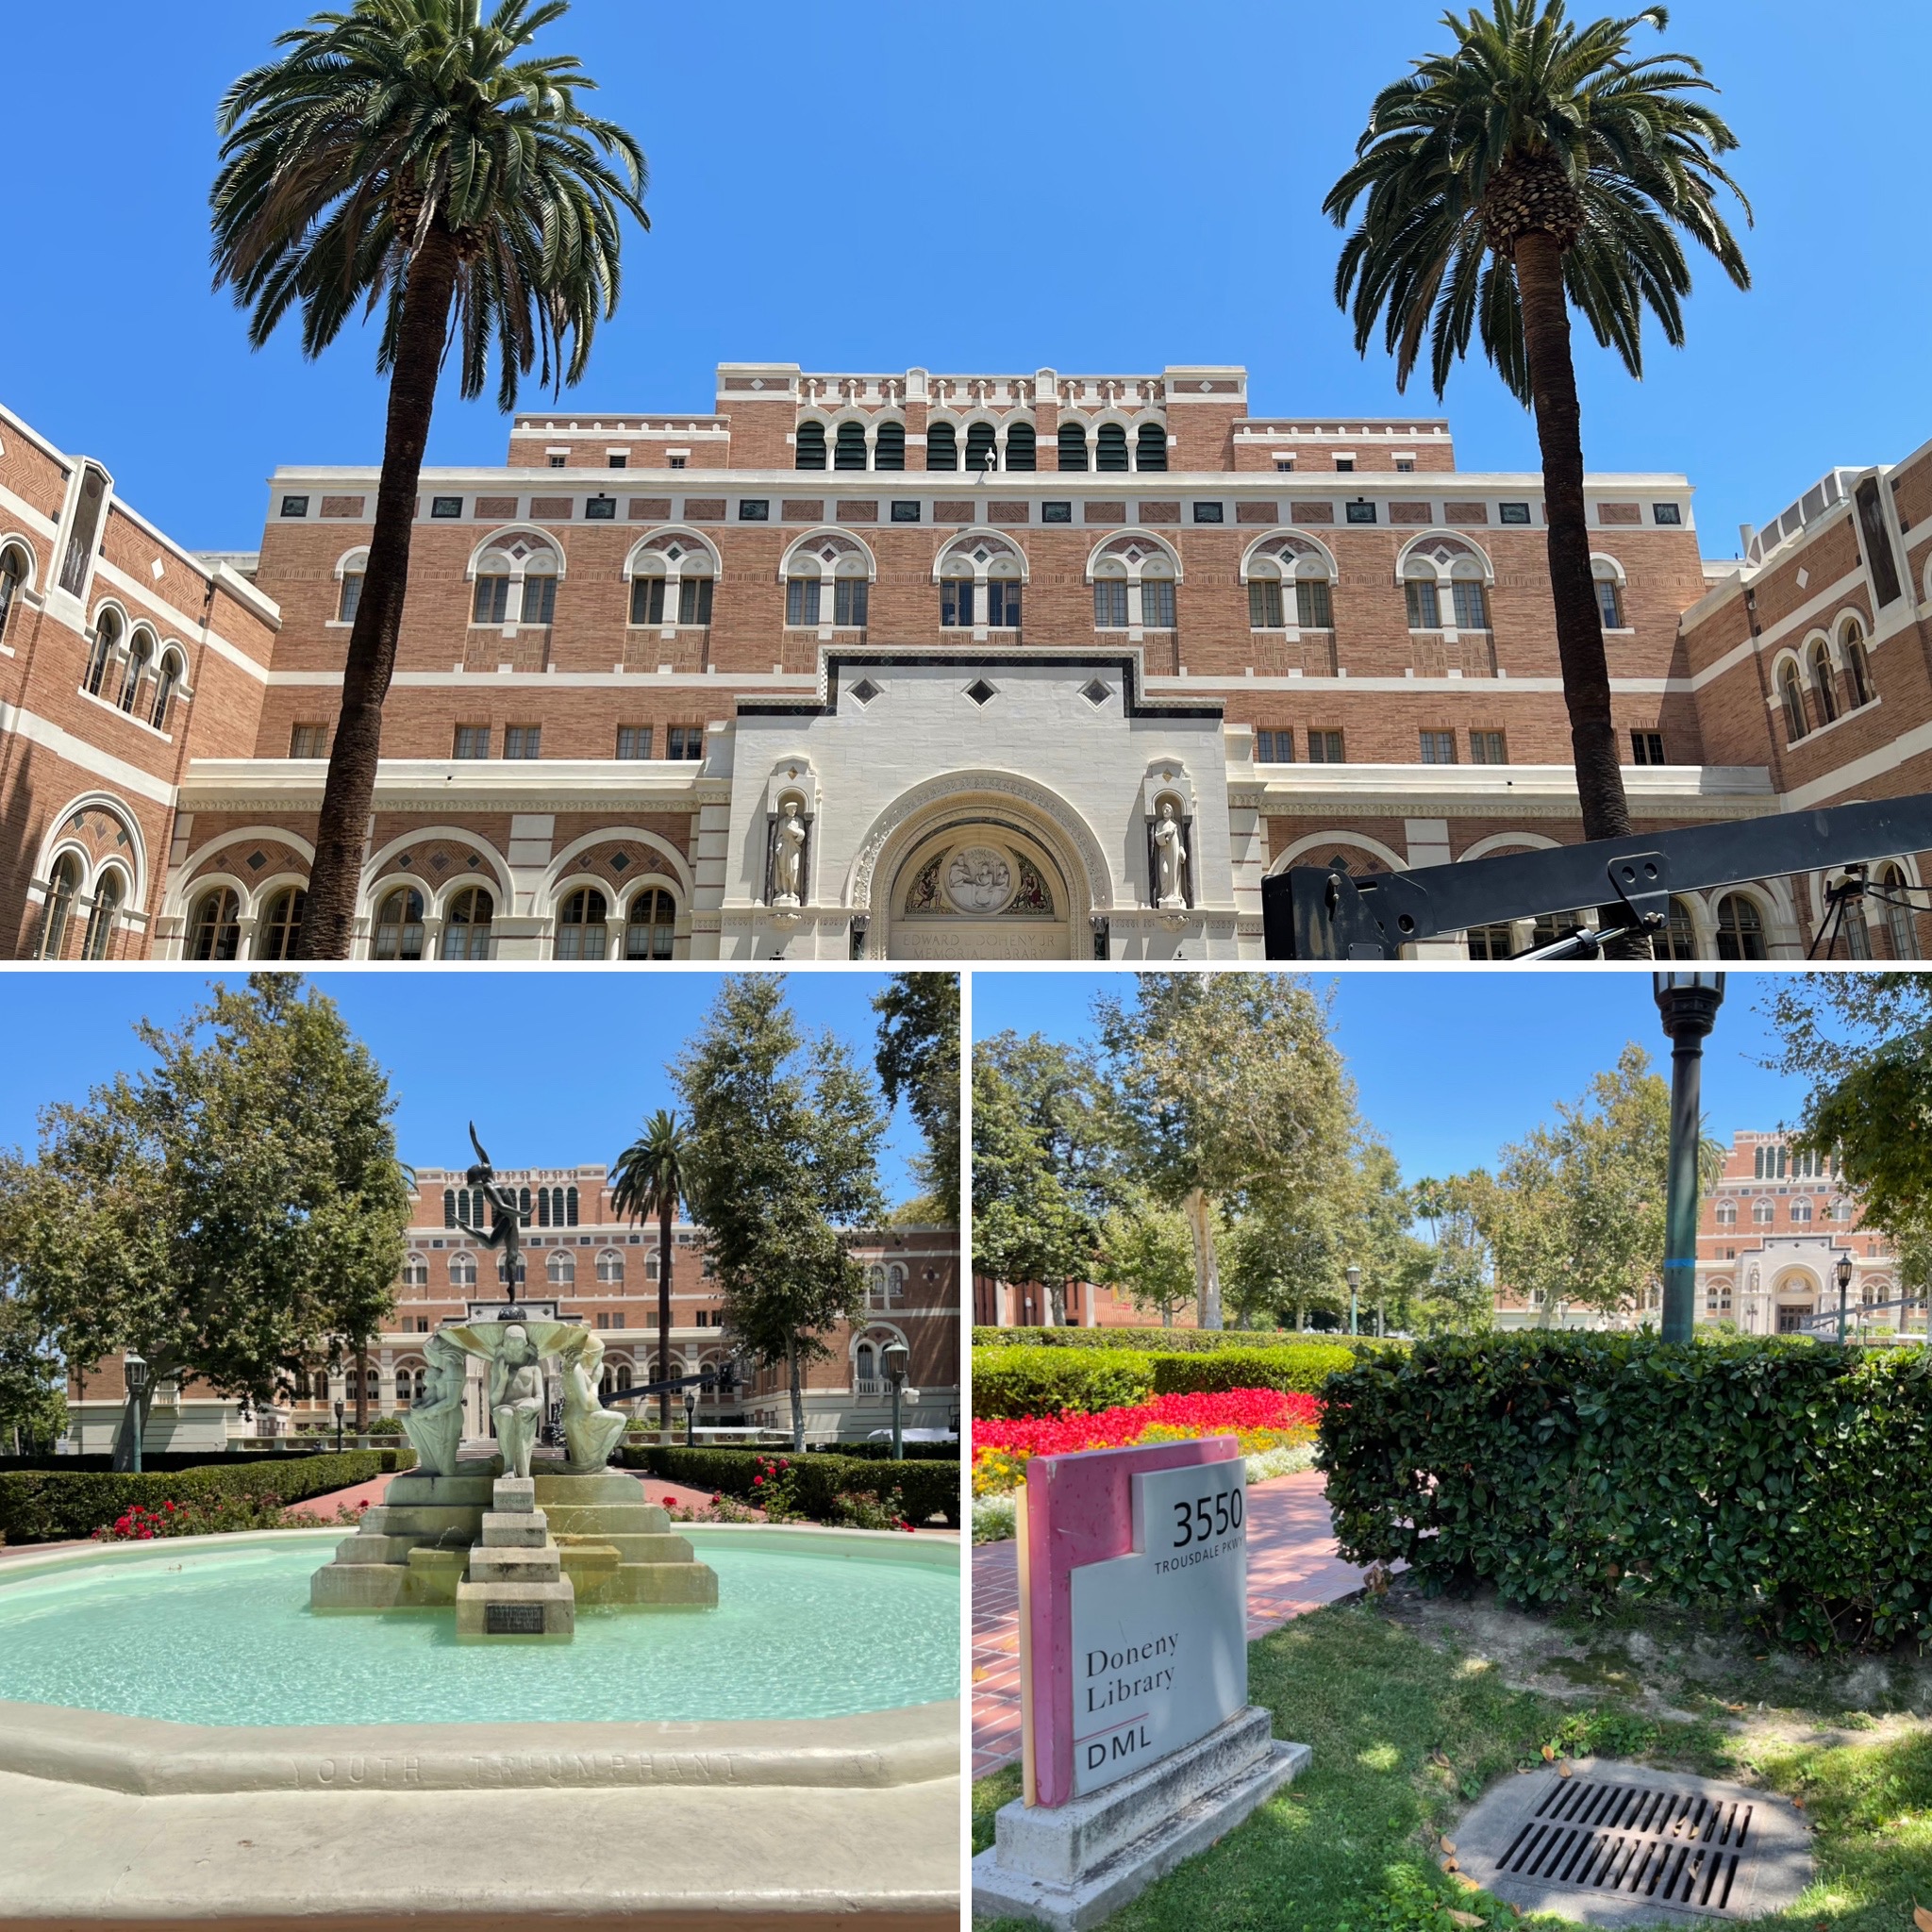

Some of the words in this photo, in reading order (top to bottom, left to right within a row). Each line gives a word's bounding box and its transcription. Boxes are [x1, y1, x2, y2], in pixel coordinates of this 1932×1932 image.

[903, 934, 960, 946] EDWARD
[975, 934, 1036, 946] DOHENY
[1040, 935, 1056, 947] JR
[913, 947, 987, 959] MEMORIAL
[991, 947, 1048, 959] LIBRARY
[1173, 1488, 1243, 1548] 3550
[1154, 1545, 1220, 1574] TROUSDALE
[1222, 1536, 1244, 1554] PKWY
[1087, 1666, 1175, 1713] Library
[1088, 1725, 1152, 1770] DML
